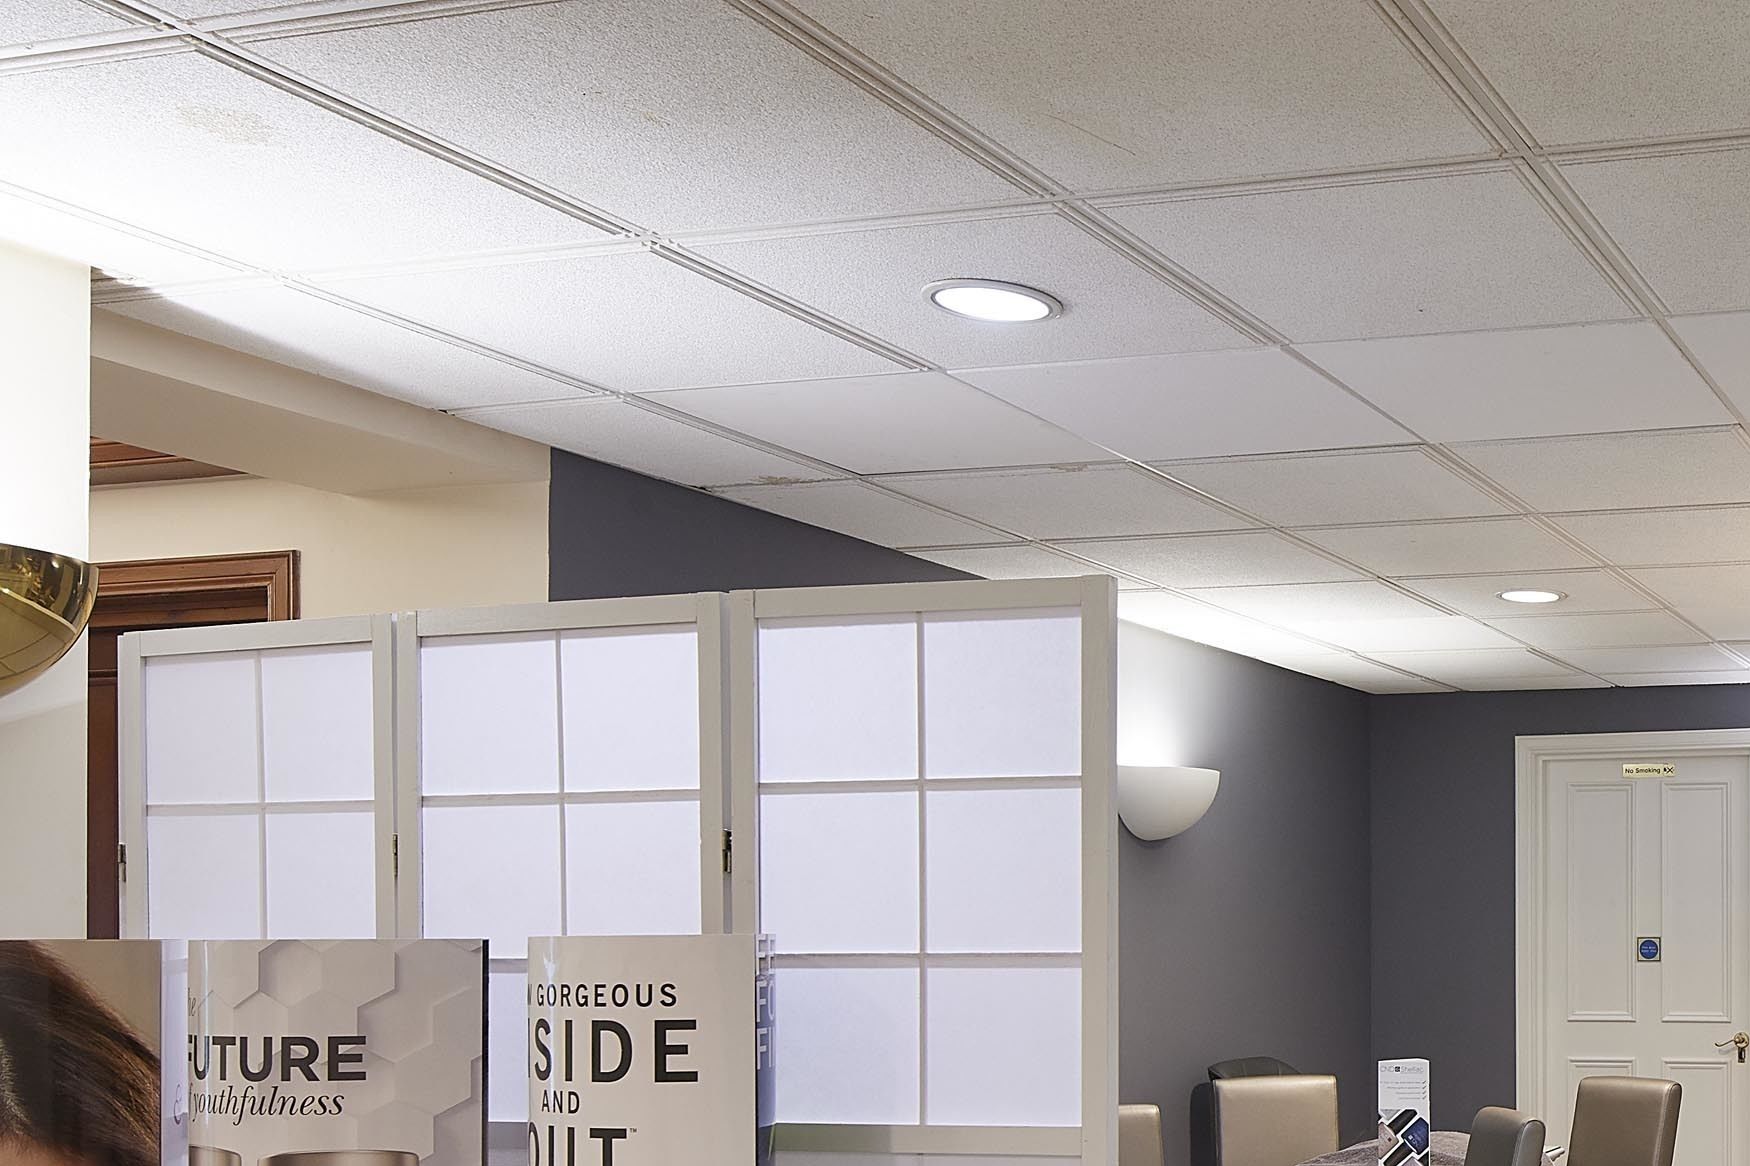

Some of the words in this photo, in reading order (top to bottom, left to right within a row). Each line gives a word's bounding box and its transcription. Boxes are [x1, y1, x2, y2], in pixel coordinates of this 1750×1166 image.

[537, 983, 678, 1007] GORGEOUS
[528, 1018, 699, 1083] SIDE
[192, 1084, 345, 1127] youthfulness
[541, 1089, 580, 1114] AND
